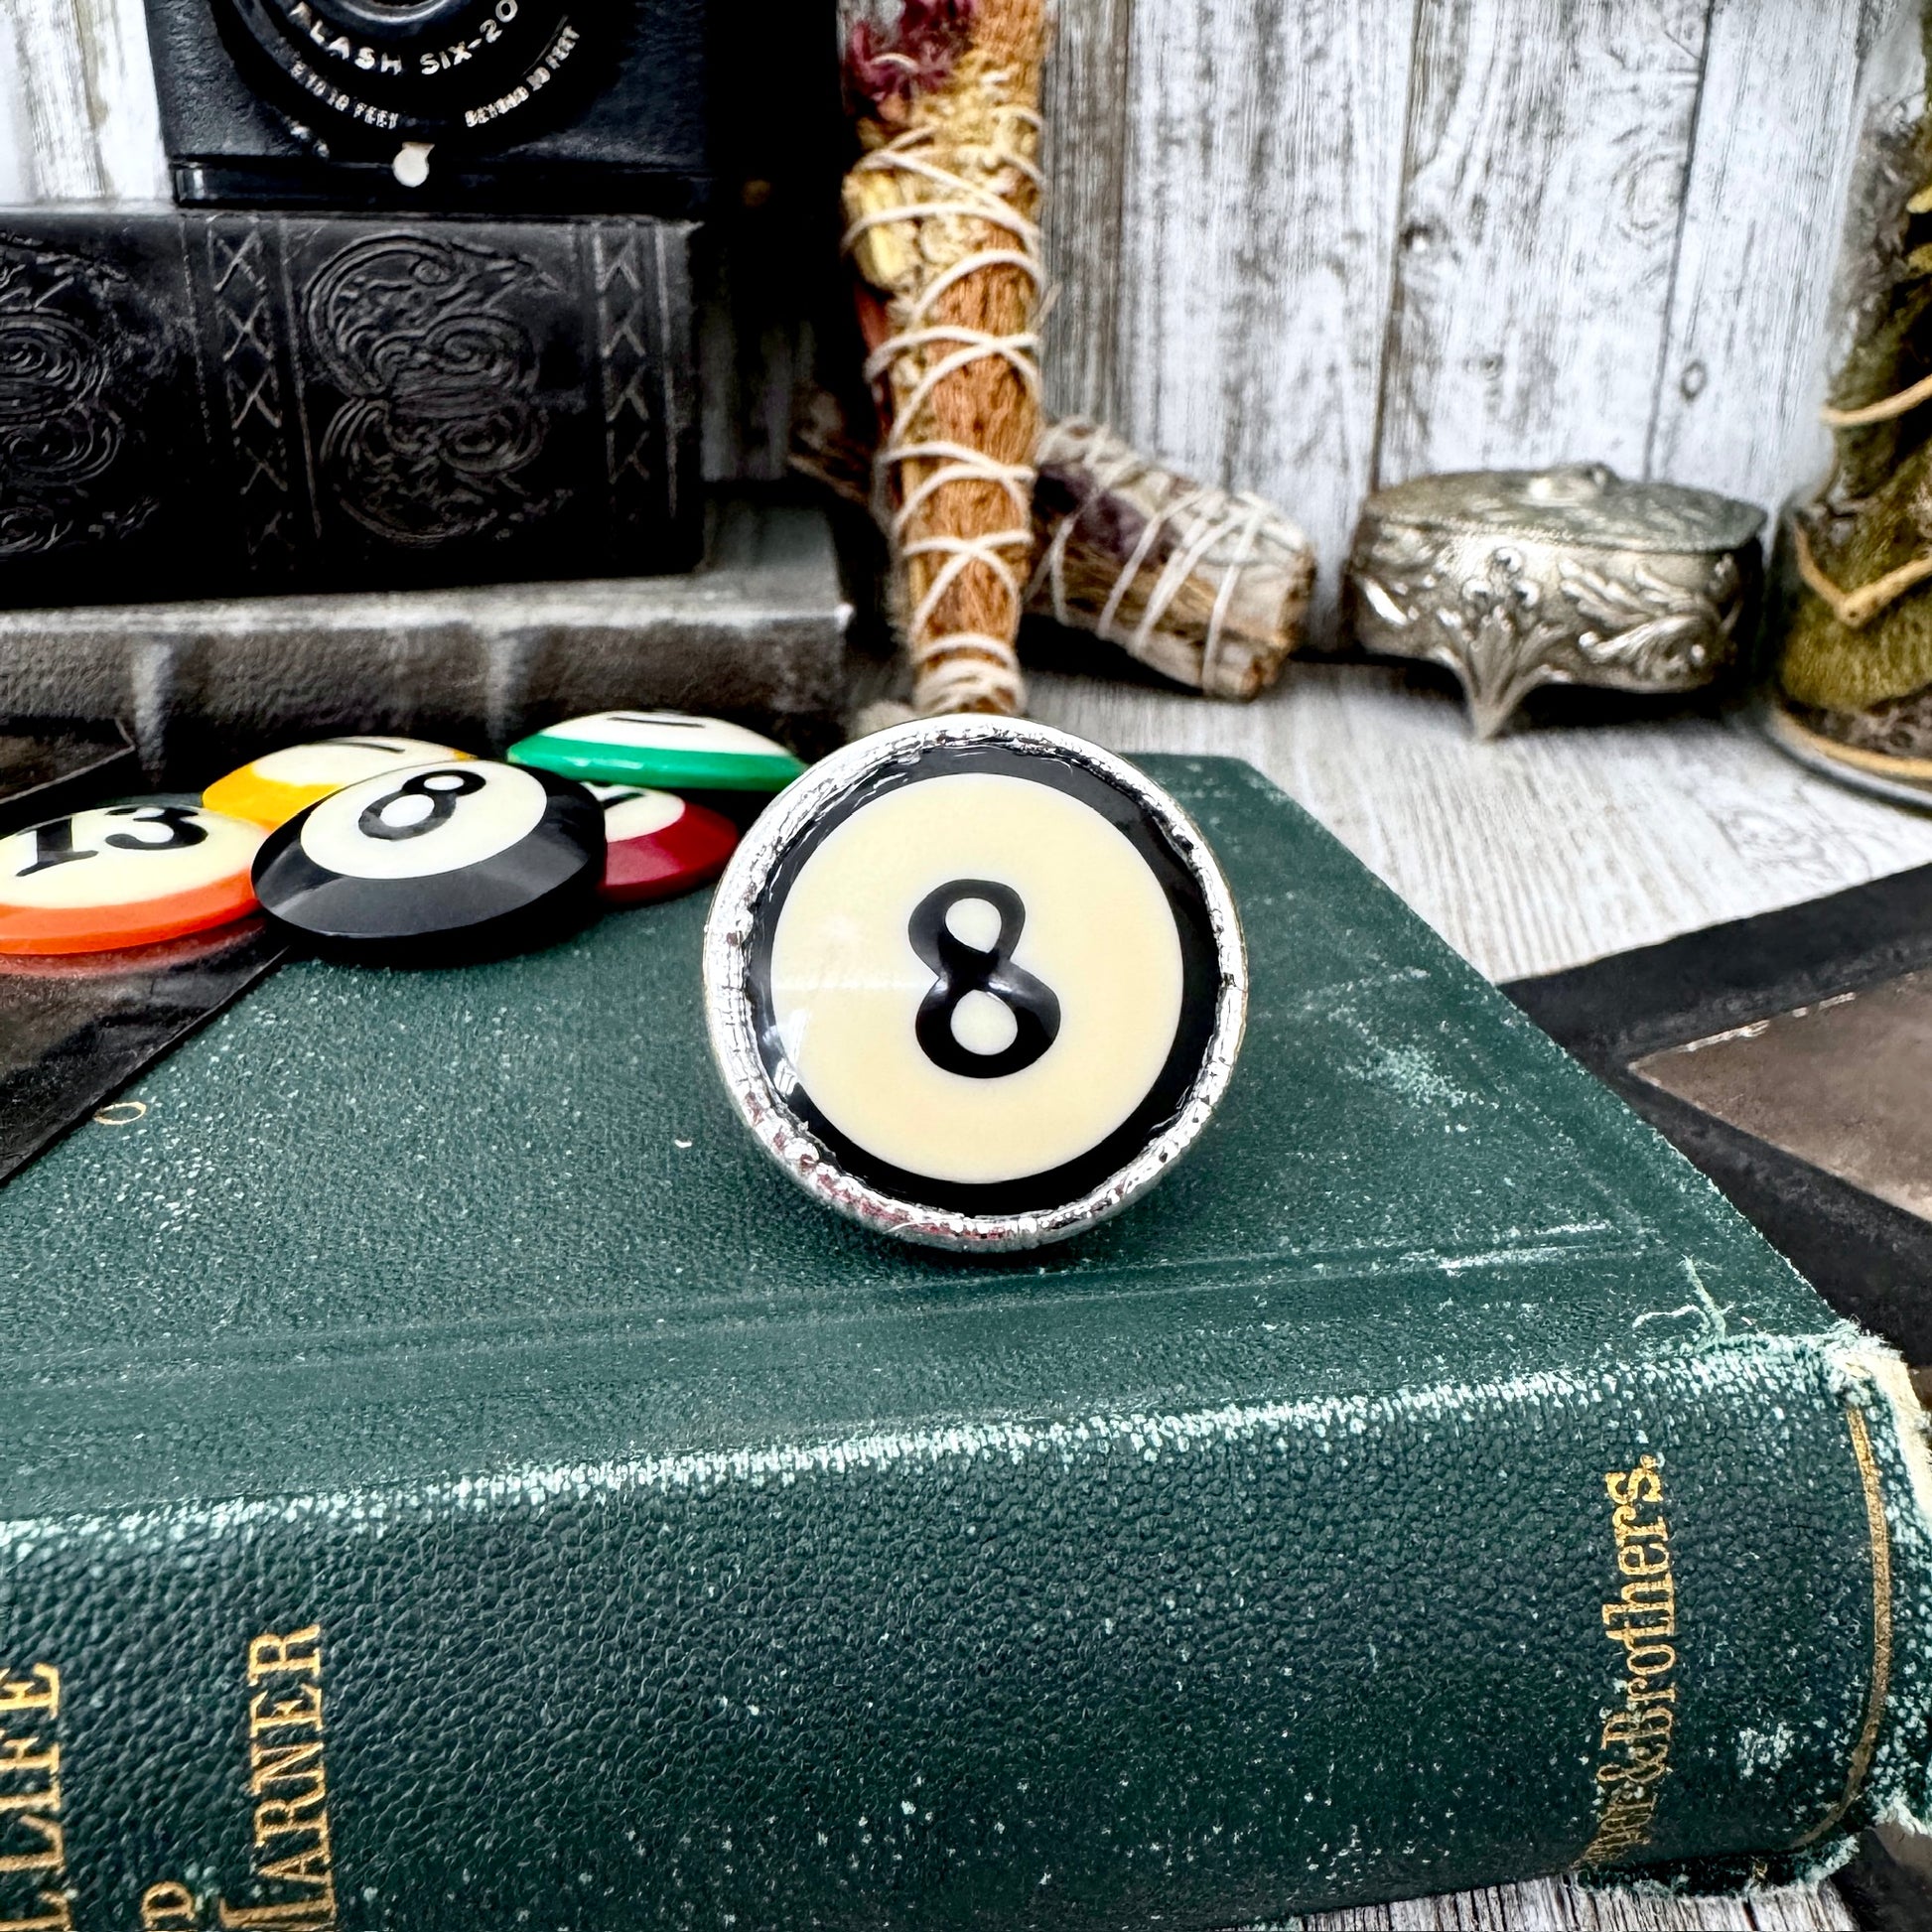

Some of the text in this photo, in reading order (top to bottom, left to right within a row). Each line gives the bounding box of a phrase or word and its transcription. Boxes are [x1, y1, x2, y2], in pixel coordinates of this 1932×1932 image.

[419, 0, 518, 75] SIX-20
[16, 806, 208, 877] 13
[357, 769, 486, 841] 8
[908, 879, 1060, 1079] 8
